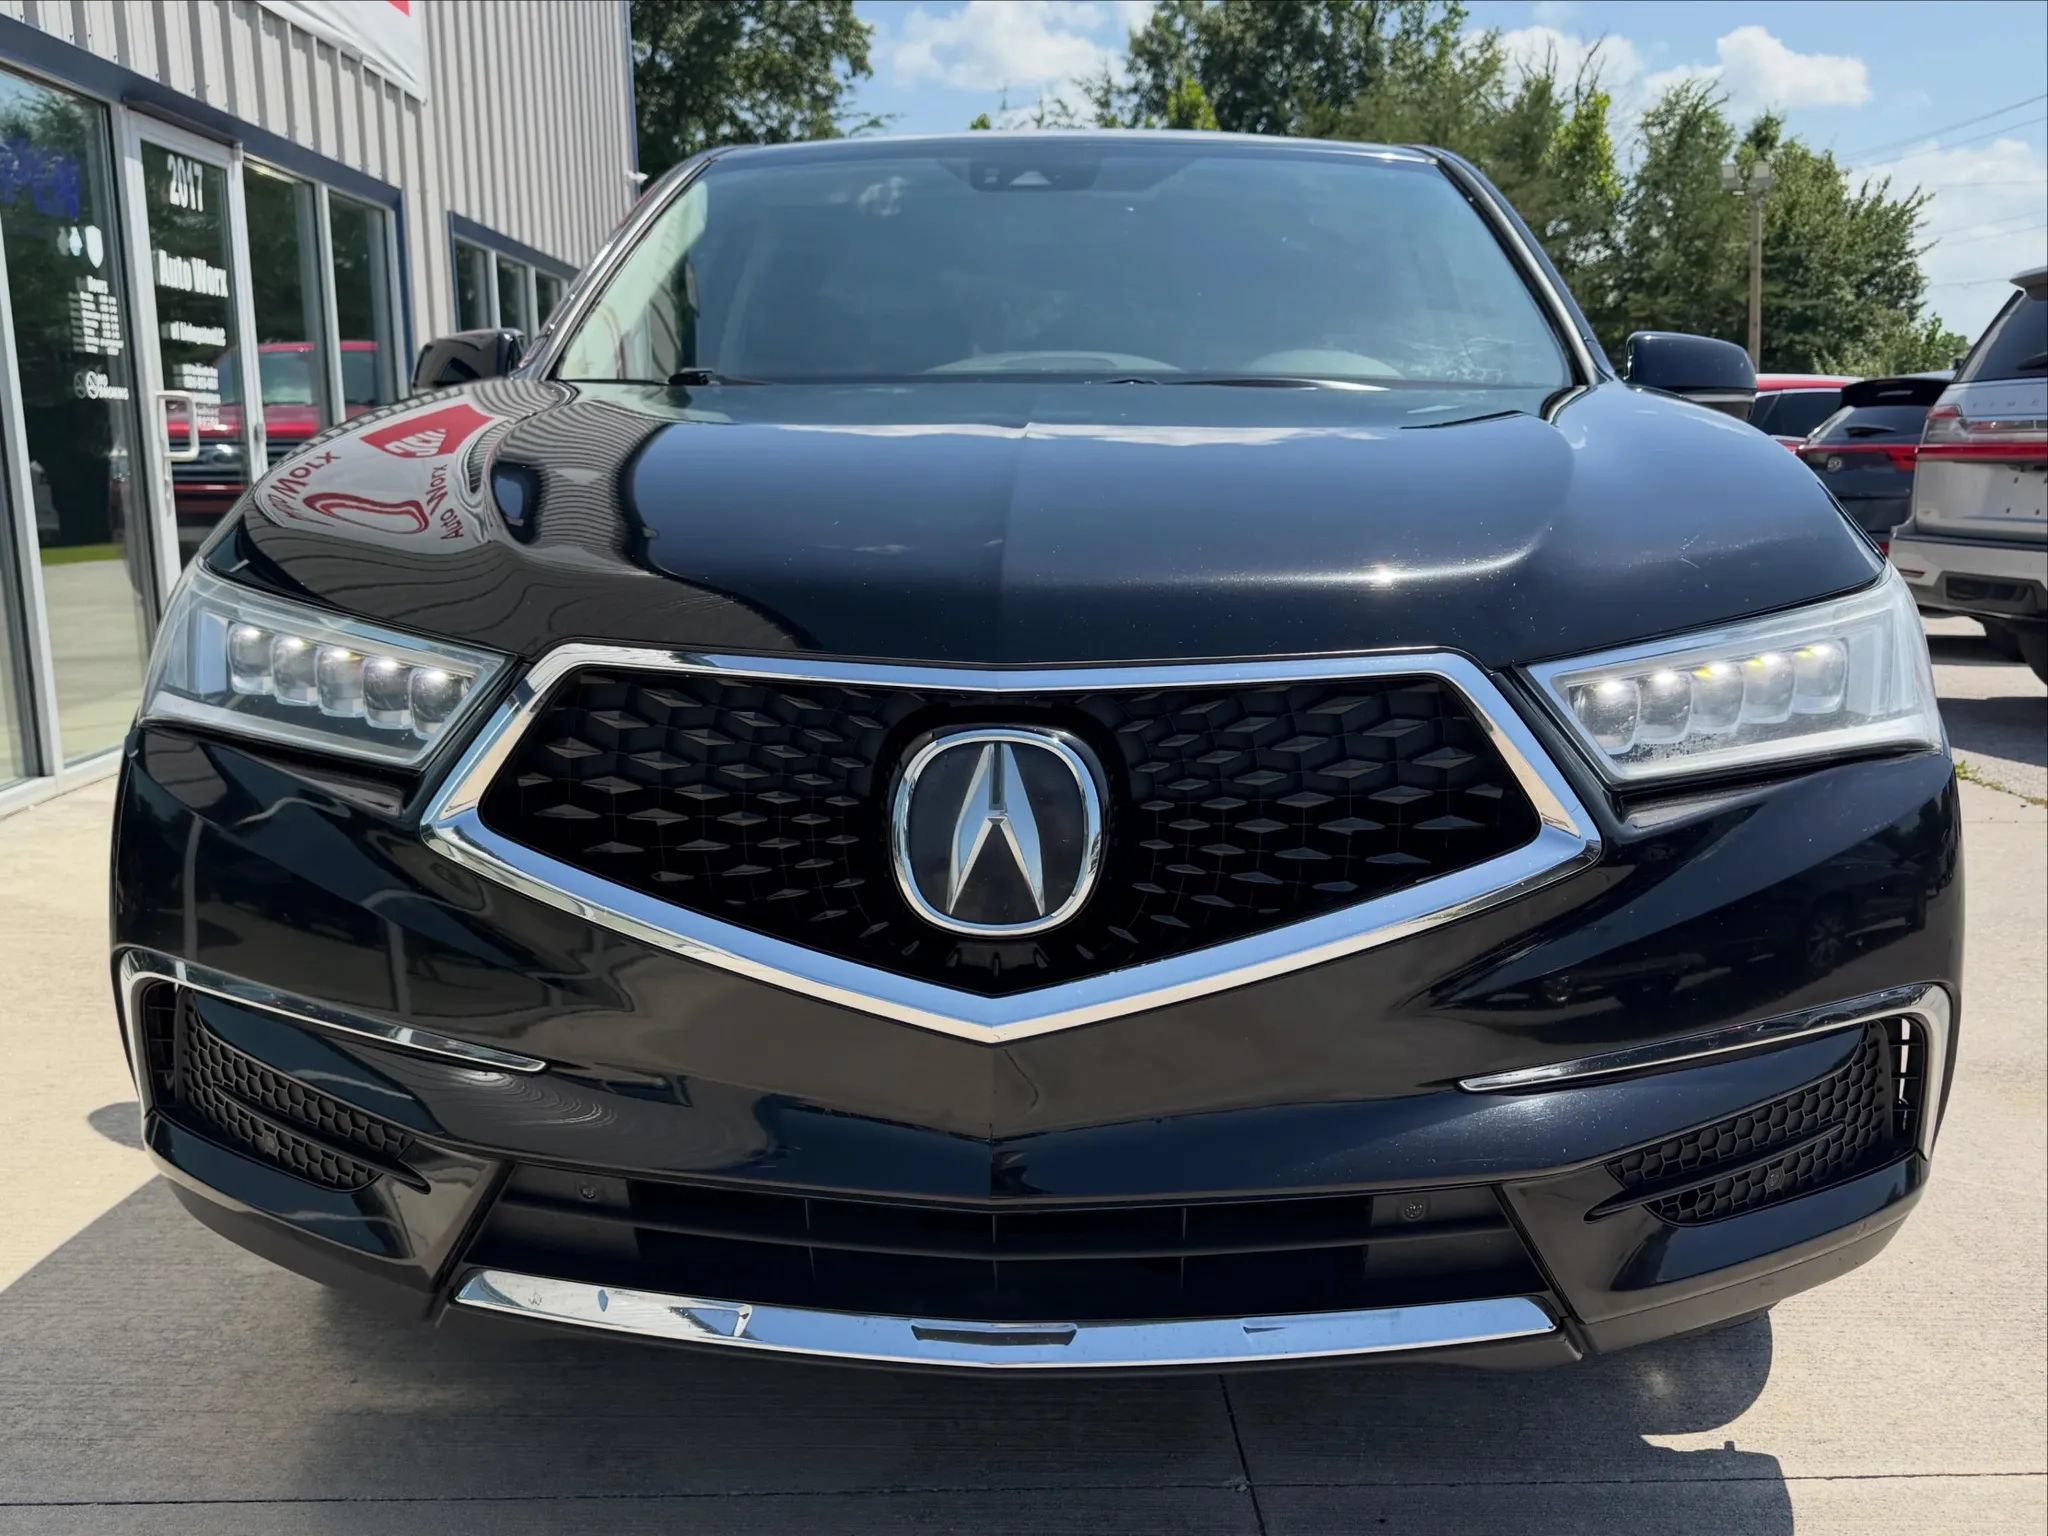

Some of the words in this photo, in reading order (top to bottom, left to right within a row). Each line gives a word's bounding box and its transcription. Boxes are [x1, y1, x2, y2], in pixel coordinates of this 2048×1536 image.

[168, 154, 204, 212] 2017
[159, 249, 193, 292] Auto
[192, 257, 229, 298] Worx
